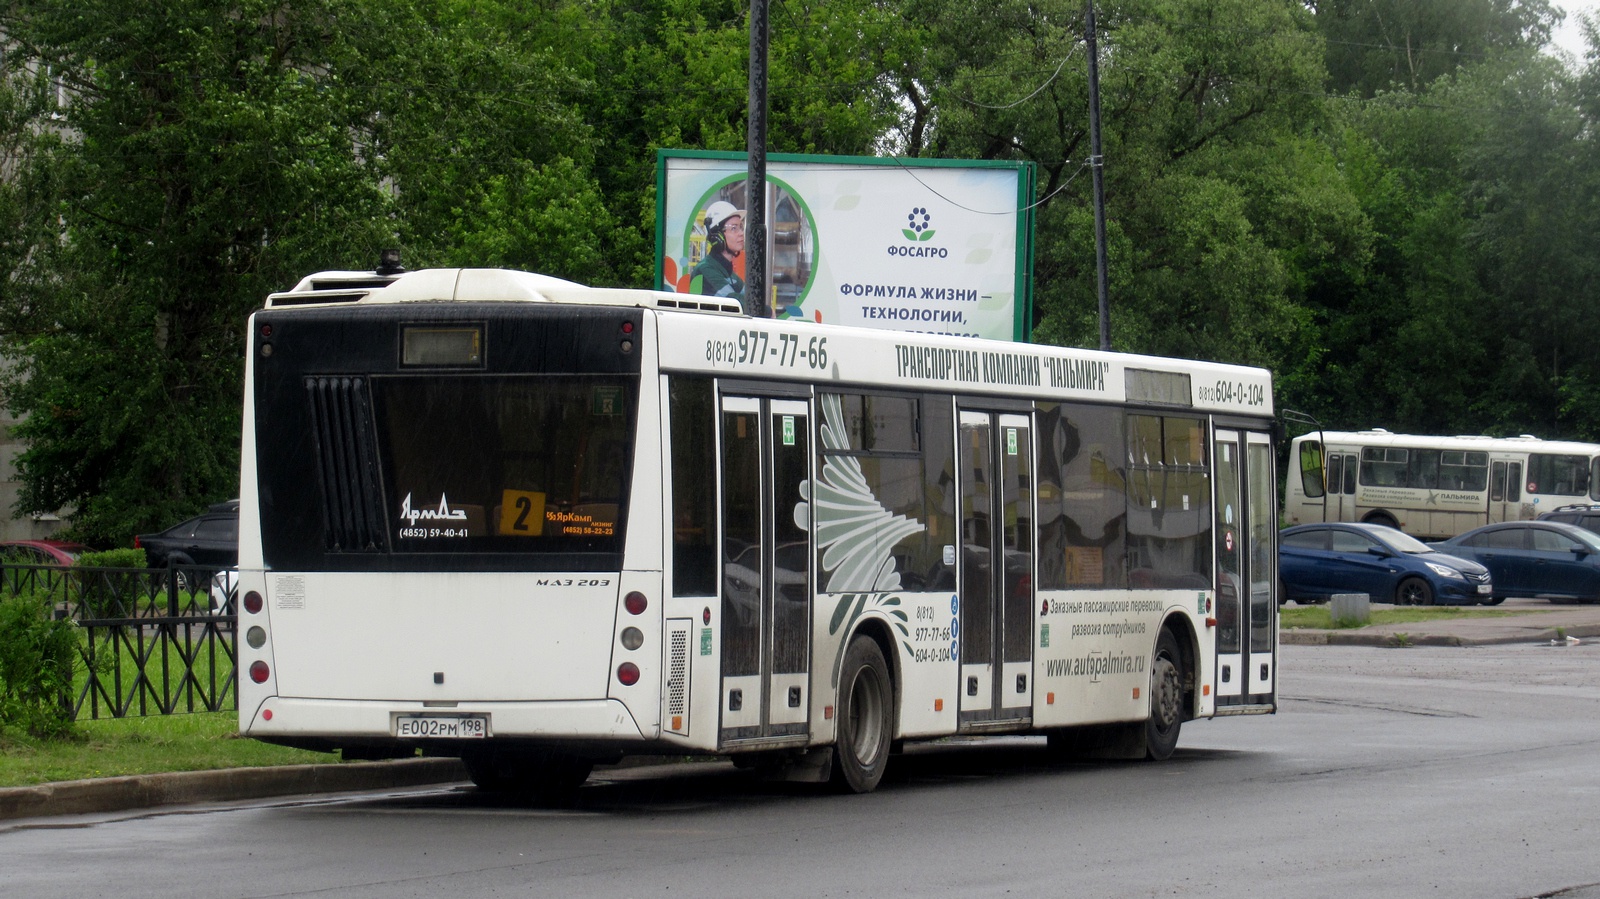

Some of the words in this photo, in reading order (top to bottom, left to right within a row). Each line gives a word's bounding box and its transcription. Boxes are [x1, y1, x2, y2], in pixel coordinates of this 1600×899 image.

[887, 245, 948, 259] ФОСАГРО
[840, 283, 917, 299] ФОРМУЛА
[921, 287, 977, 302] ЖИЗНИ
[862, 306, 967, 325] ТЕХНОЛОГИИ,
[895, 344, 979, 383] ТРАНСПОРТНАЯ
[982, 351, 1041, 387] КОМПАНИЯ
[1440, 493, 1480, 501] ПАЛЬМИРА
[513, 496, 532, 531] 2
[556, 512, 592, 523] ЯрКамп
[399, 528, 428, 539] (4852)
[430, 528, 468, 538] 59-40-41
[584, 527, 613, 535] 58-22-23
[536, 579, 574, 587] МАЗ
[577, 579, 611, 587] 203
[916, 606, 935, 622] 8(812)
[1050, 598, 1083, 614] Заказные
[1083, 599, 1130, 616] пассажирские
[915, 627, 950, 642] 977-77-66
[1071, 623, 1101, 639] развозка
[1102, 618, 1146, 639] сотрудников
[915, 648, 950, 663] 604-0-104
[1047, 650, 1145, 680] www.autopalmira.ru
[460, 720, 481, 732] 198
